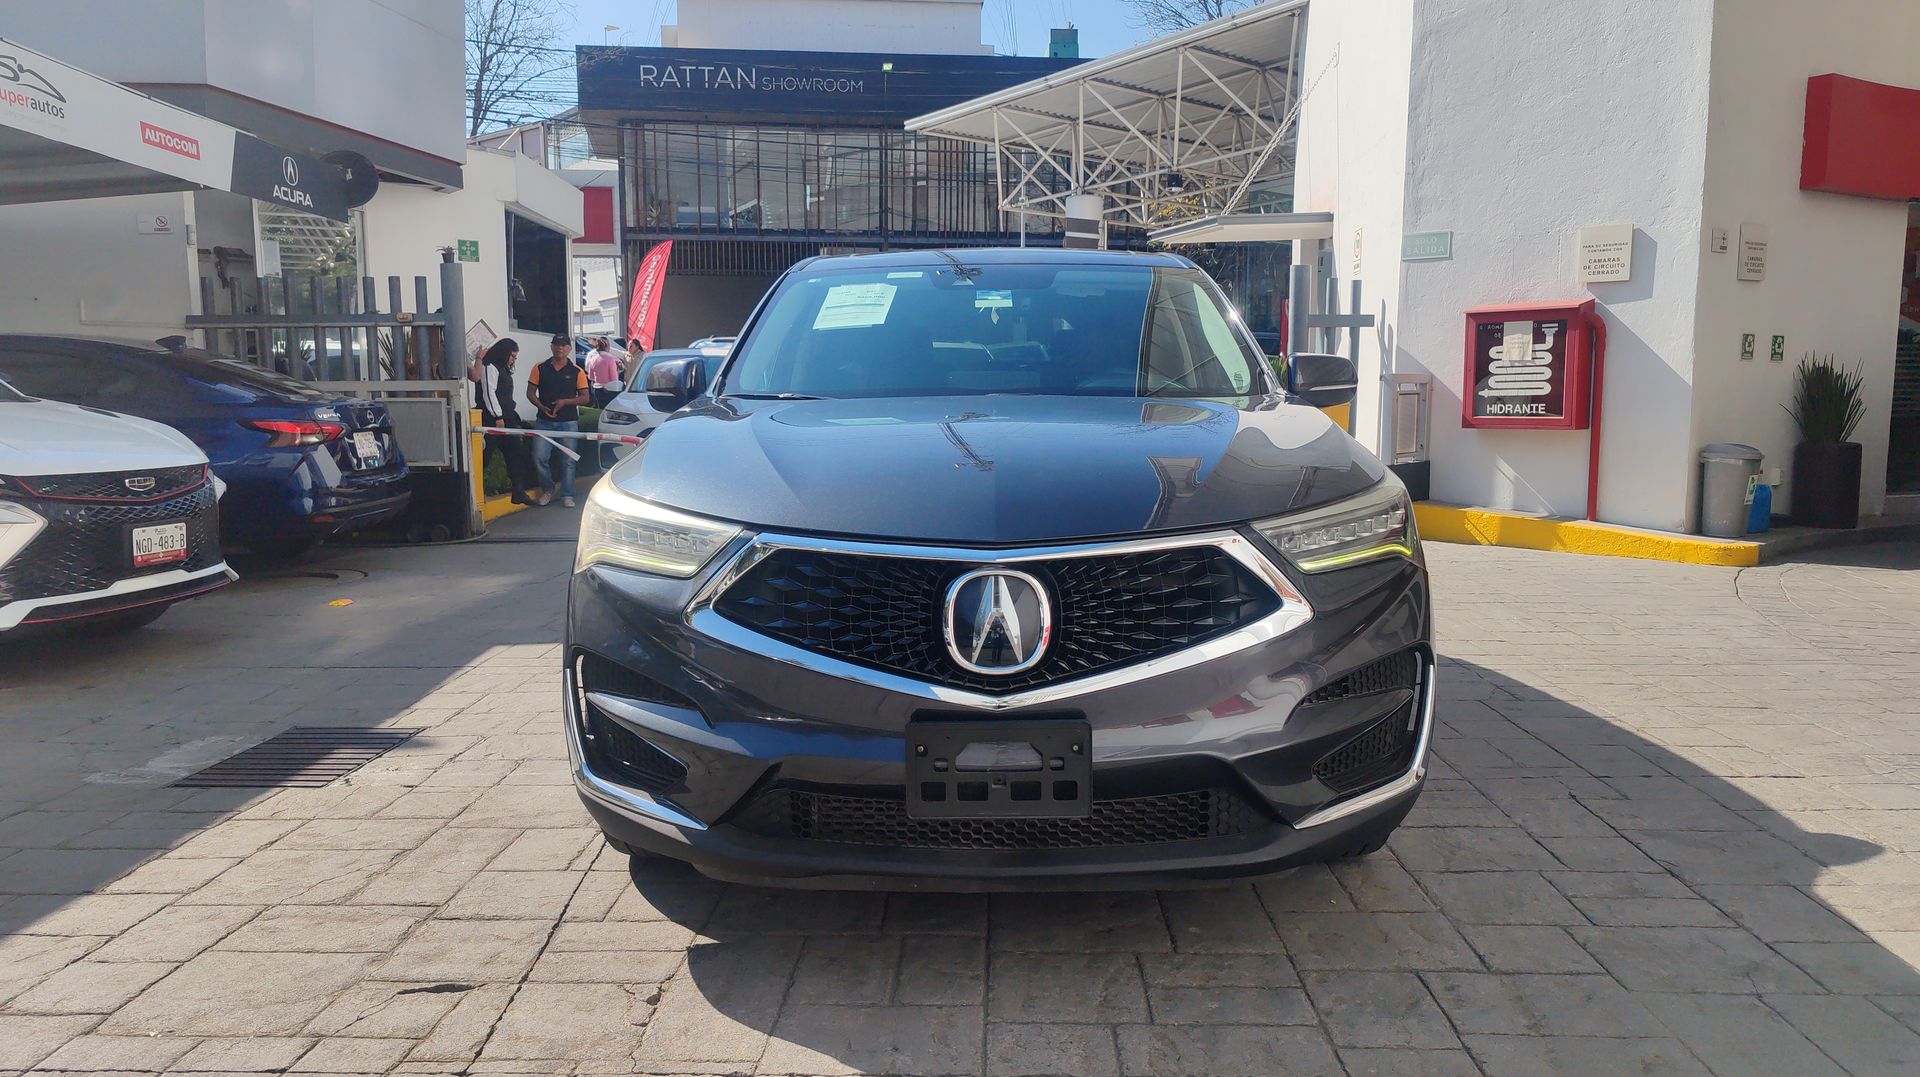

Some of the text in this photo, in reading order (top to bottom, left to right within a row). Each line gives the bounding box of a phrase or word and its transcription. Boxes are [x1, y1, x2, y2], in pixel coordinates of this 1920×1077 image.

[639, 64, 864, 93] RATTAN SHOWROOM
[0, 87, 65, 119] uperautos
[144, 127, 198, 156] AUTOCOM
[272, 184, 314, 209] ACURA
[1406, 245, 1445, 256] SALIDA
[1594, 262, 1625, 270] CIRCUITO
[1486, 403, 1546, 414] HIDRANTE
[135, 533, 185, 555] NGD-483-B
